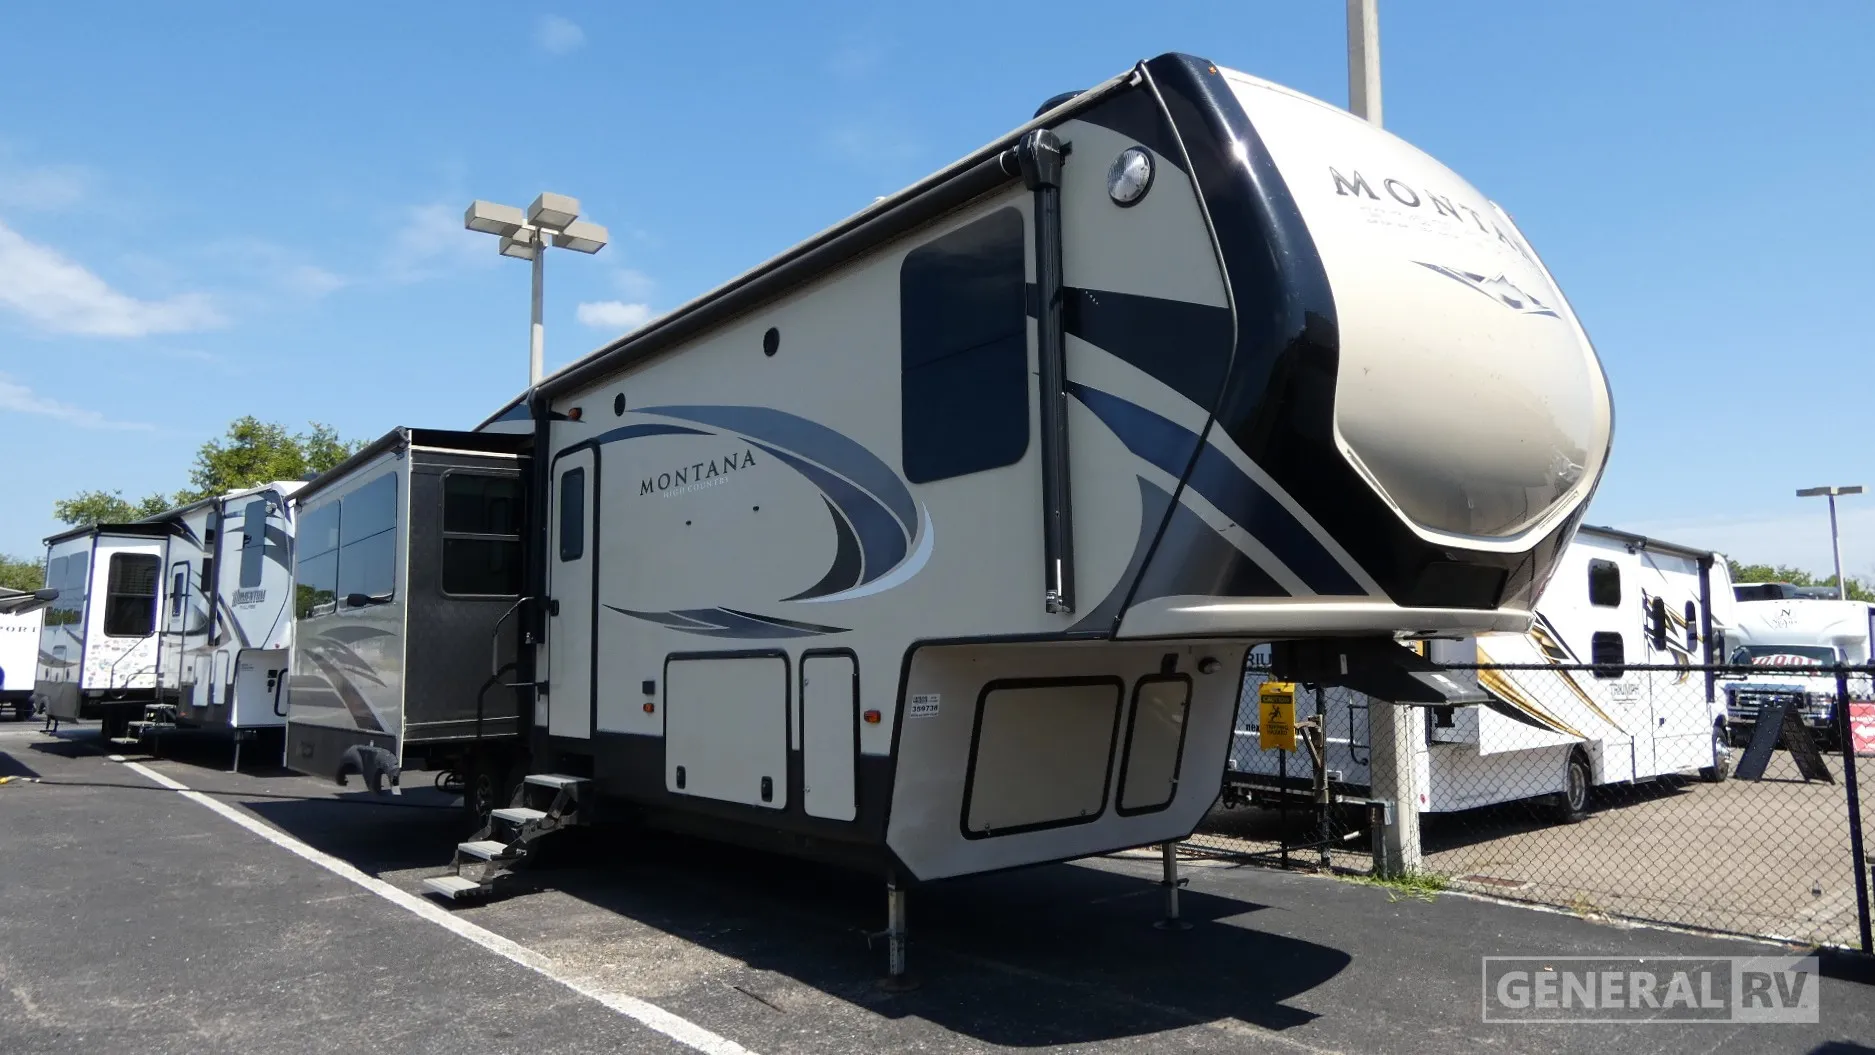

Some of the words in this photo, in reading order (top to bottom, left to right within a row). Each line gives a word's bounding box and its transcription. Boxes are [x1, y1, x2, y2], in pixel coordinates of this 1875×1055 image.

[640, 449, 756, 496] MONTANA
[663, 487, 685, 499] HIGH
[687, 477, 729, 493] COUNTRY
[1262, 695, 1291, 703] CAUTION
